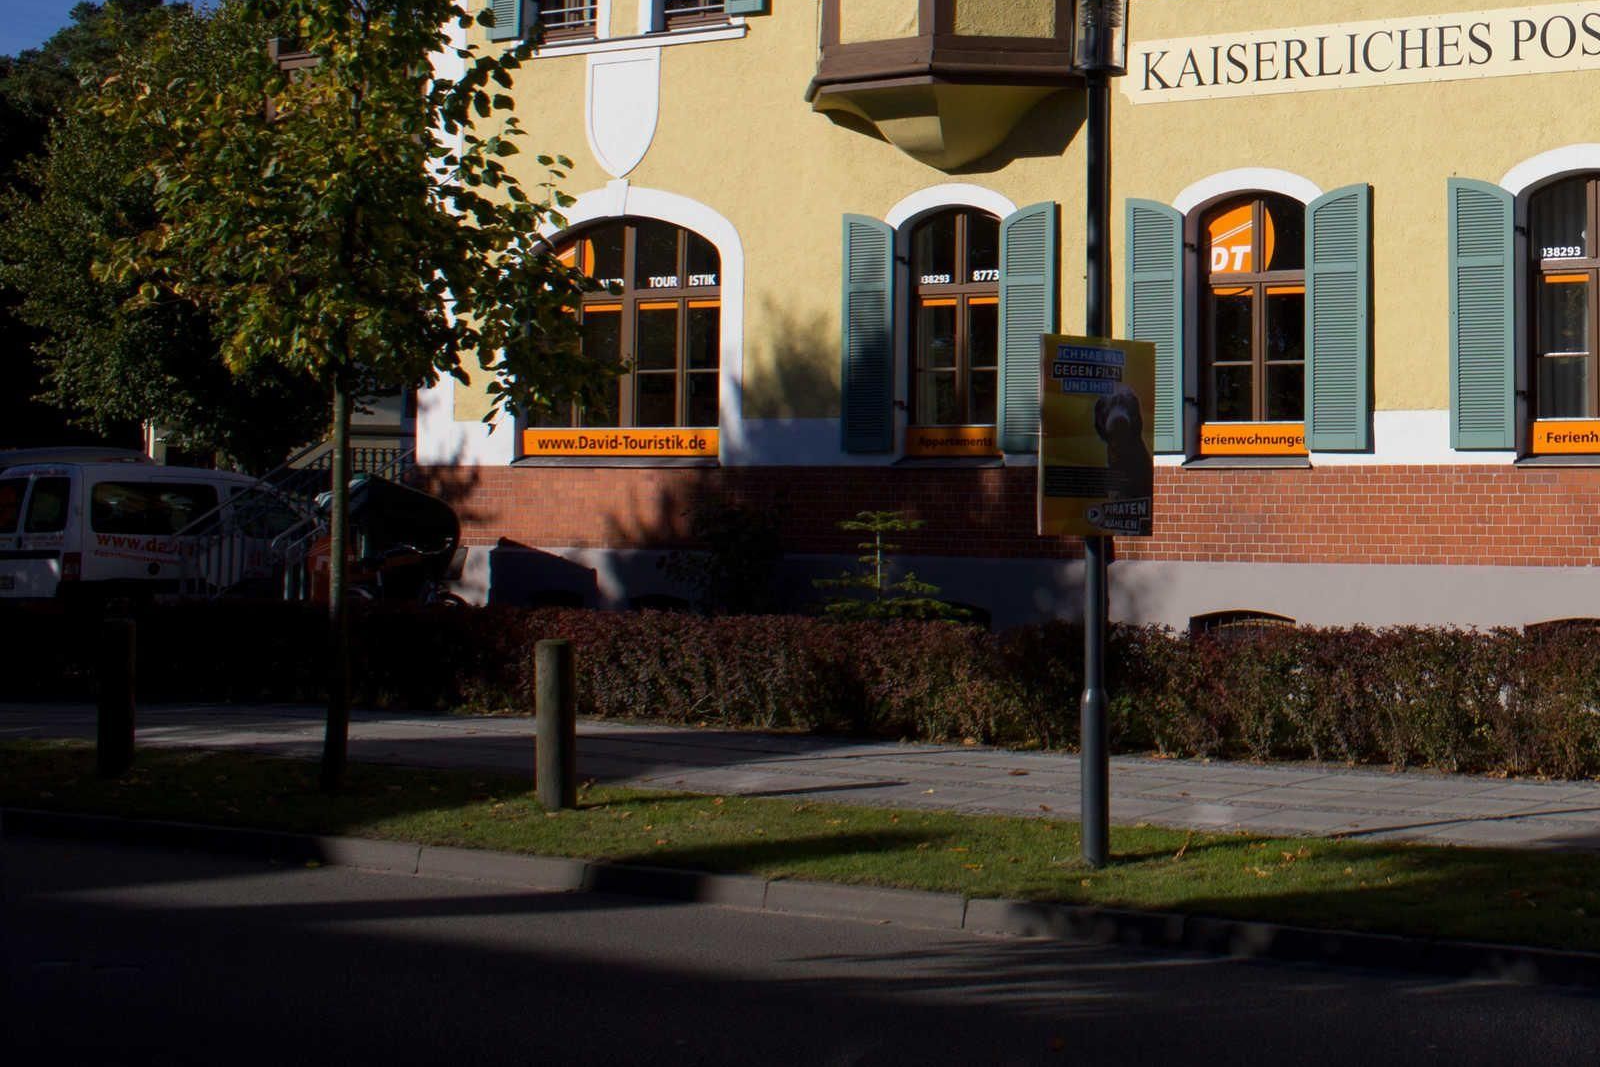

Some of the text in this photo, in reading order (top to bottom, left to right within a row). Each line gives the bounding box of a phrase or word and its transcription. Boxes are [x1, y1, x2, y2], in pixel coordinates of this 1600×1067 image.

[1141, 22, 1493, 91] KAISERLICHES
[1211, 245, 1252, 271] DT
[649, 274, 716, 288] TOUR ISTIK
[1054, 364, 1093, 377] GEGEN
[1064, 381, 1087, 391] UND
[537, 435, 707, 450] www.David-Touristik.de
